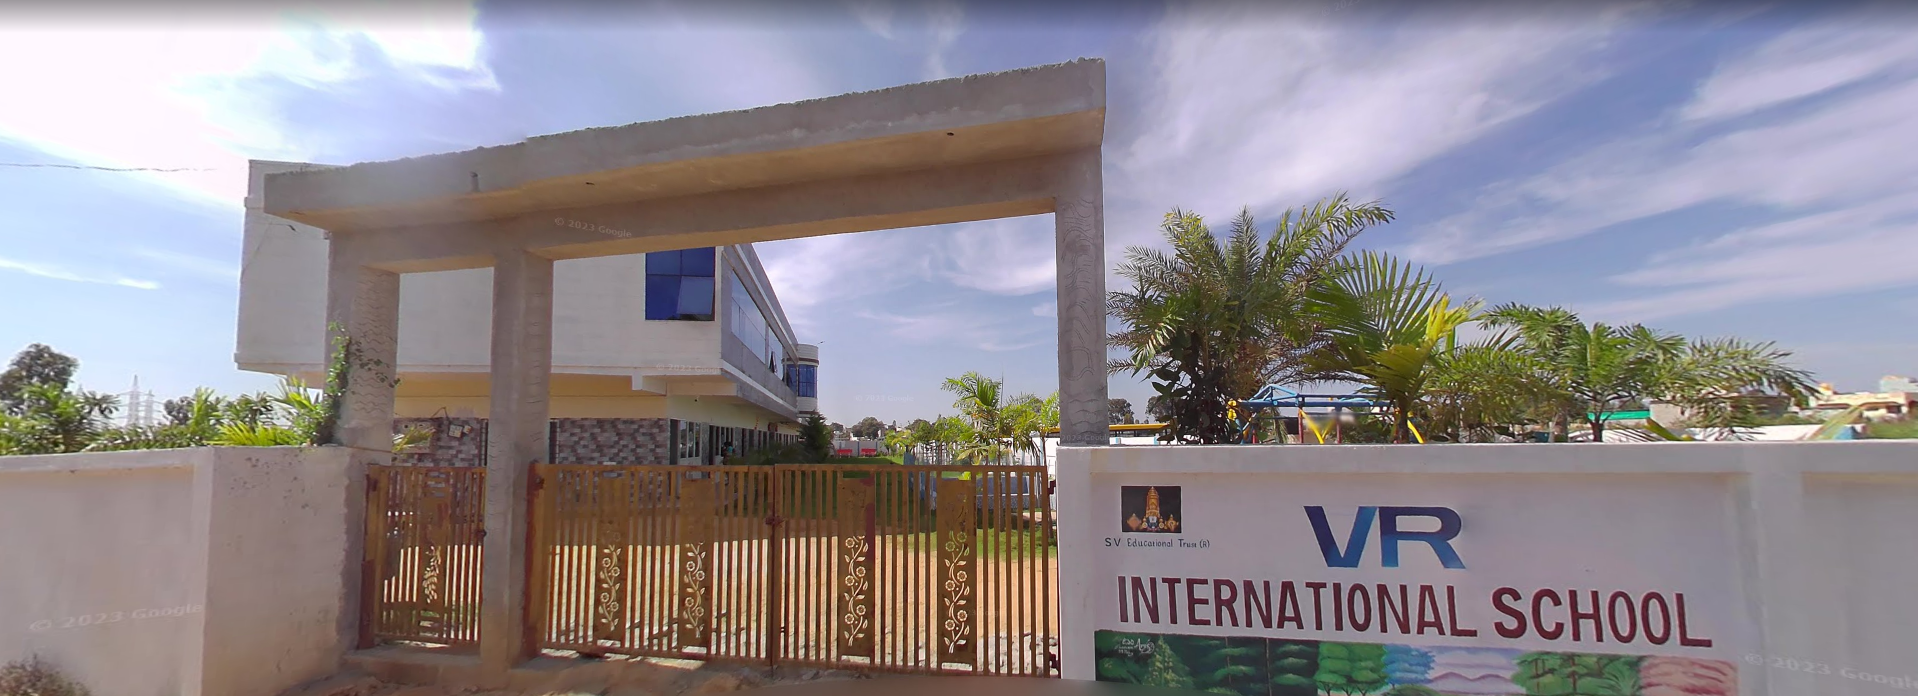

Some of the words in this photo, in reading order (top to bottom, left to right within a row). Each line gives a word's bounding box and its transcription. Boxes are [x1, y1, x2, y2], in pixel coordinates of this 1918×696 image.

[1126, 538, 1174, 549] Educational
[1303, 505, 1466, 570] VR
[1117, 575, 1478, 638] INTERNATIONAL
[1491, 586, 1713, 648] SCHOOL
